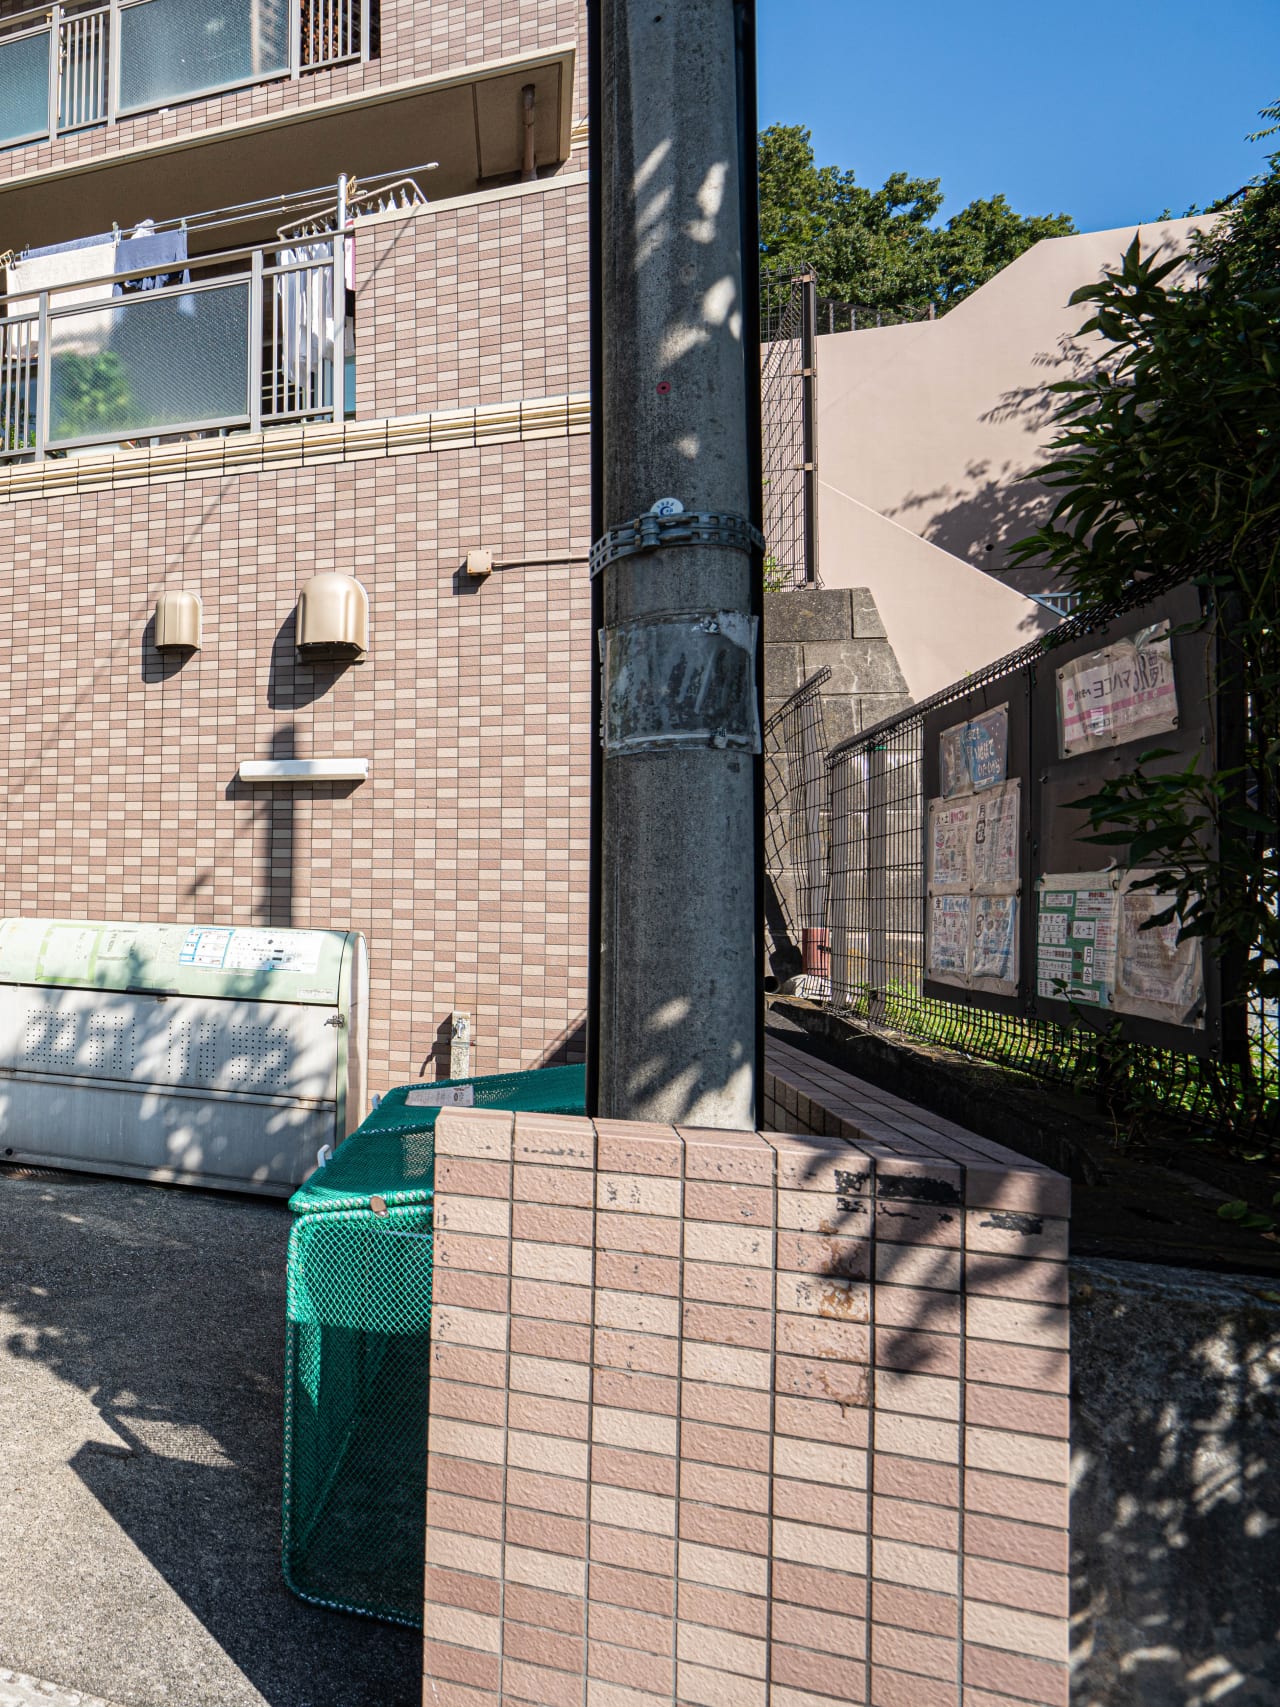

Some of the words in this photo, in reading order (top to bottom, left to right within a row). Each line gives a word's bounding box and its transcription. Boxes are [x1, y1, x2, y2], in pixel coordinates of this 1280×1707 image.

[1075, 923, 1093, 936] 火・土
[1085, 948, 1092, 962] 月
[1084, 968, 1091, 983] 金
